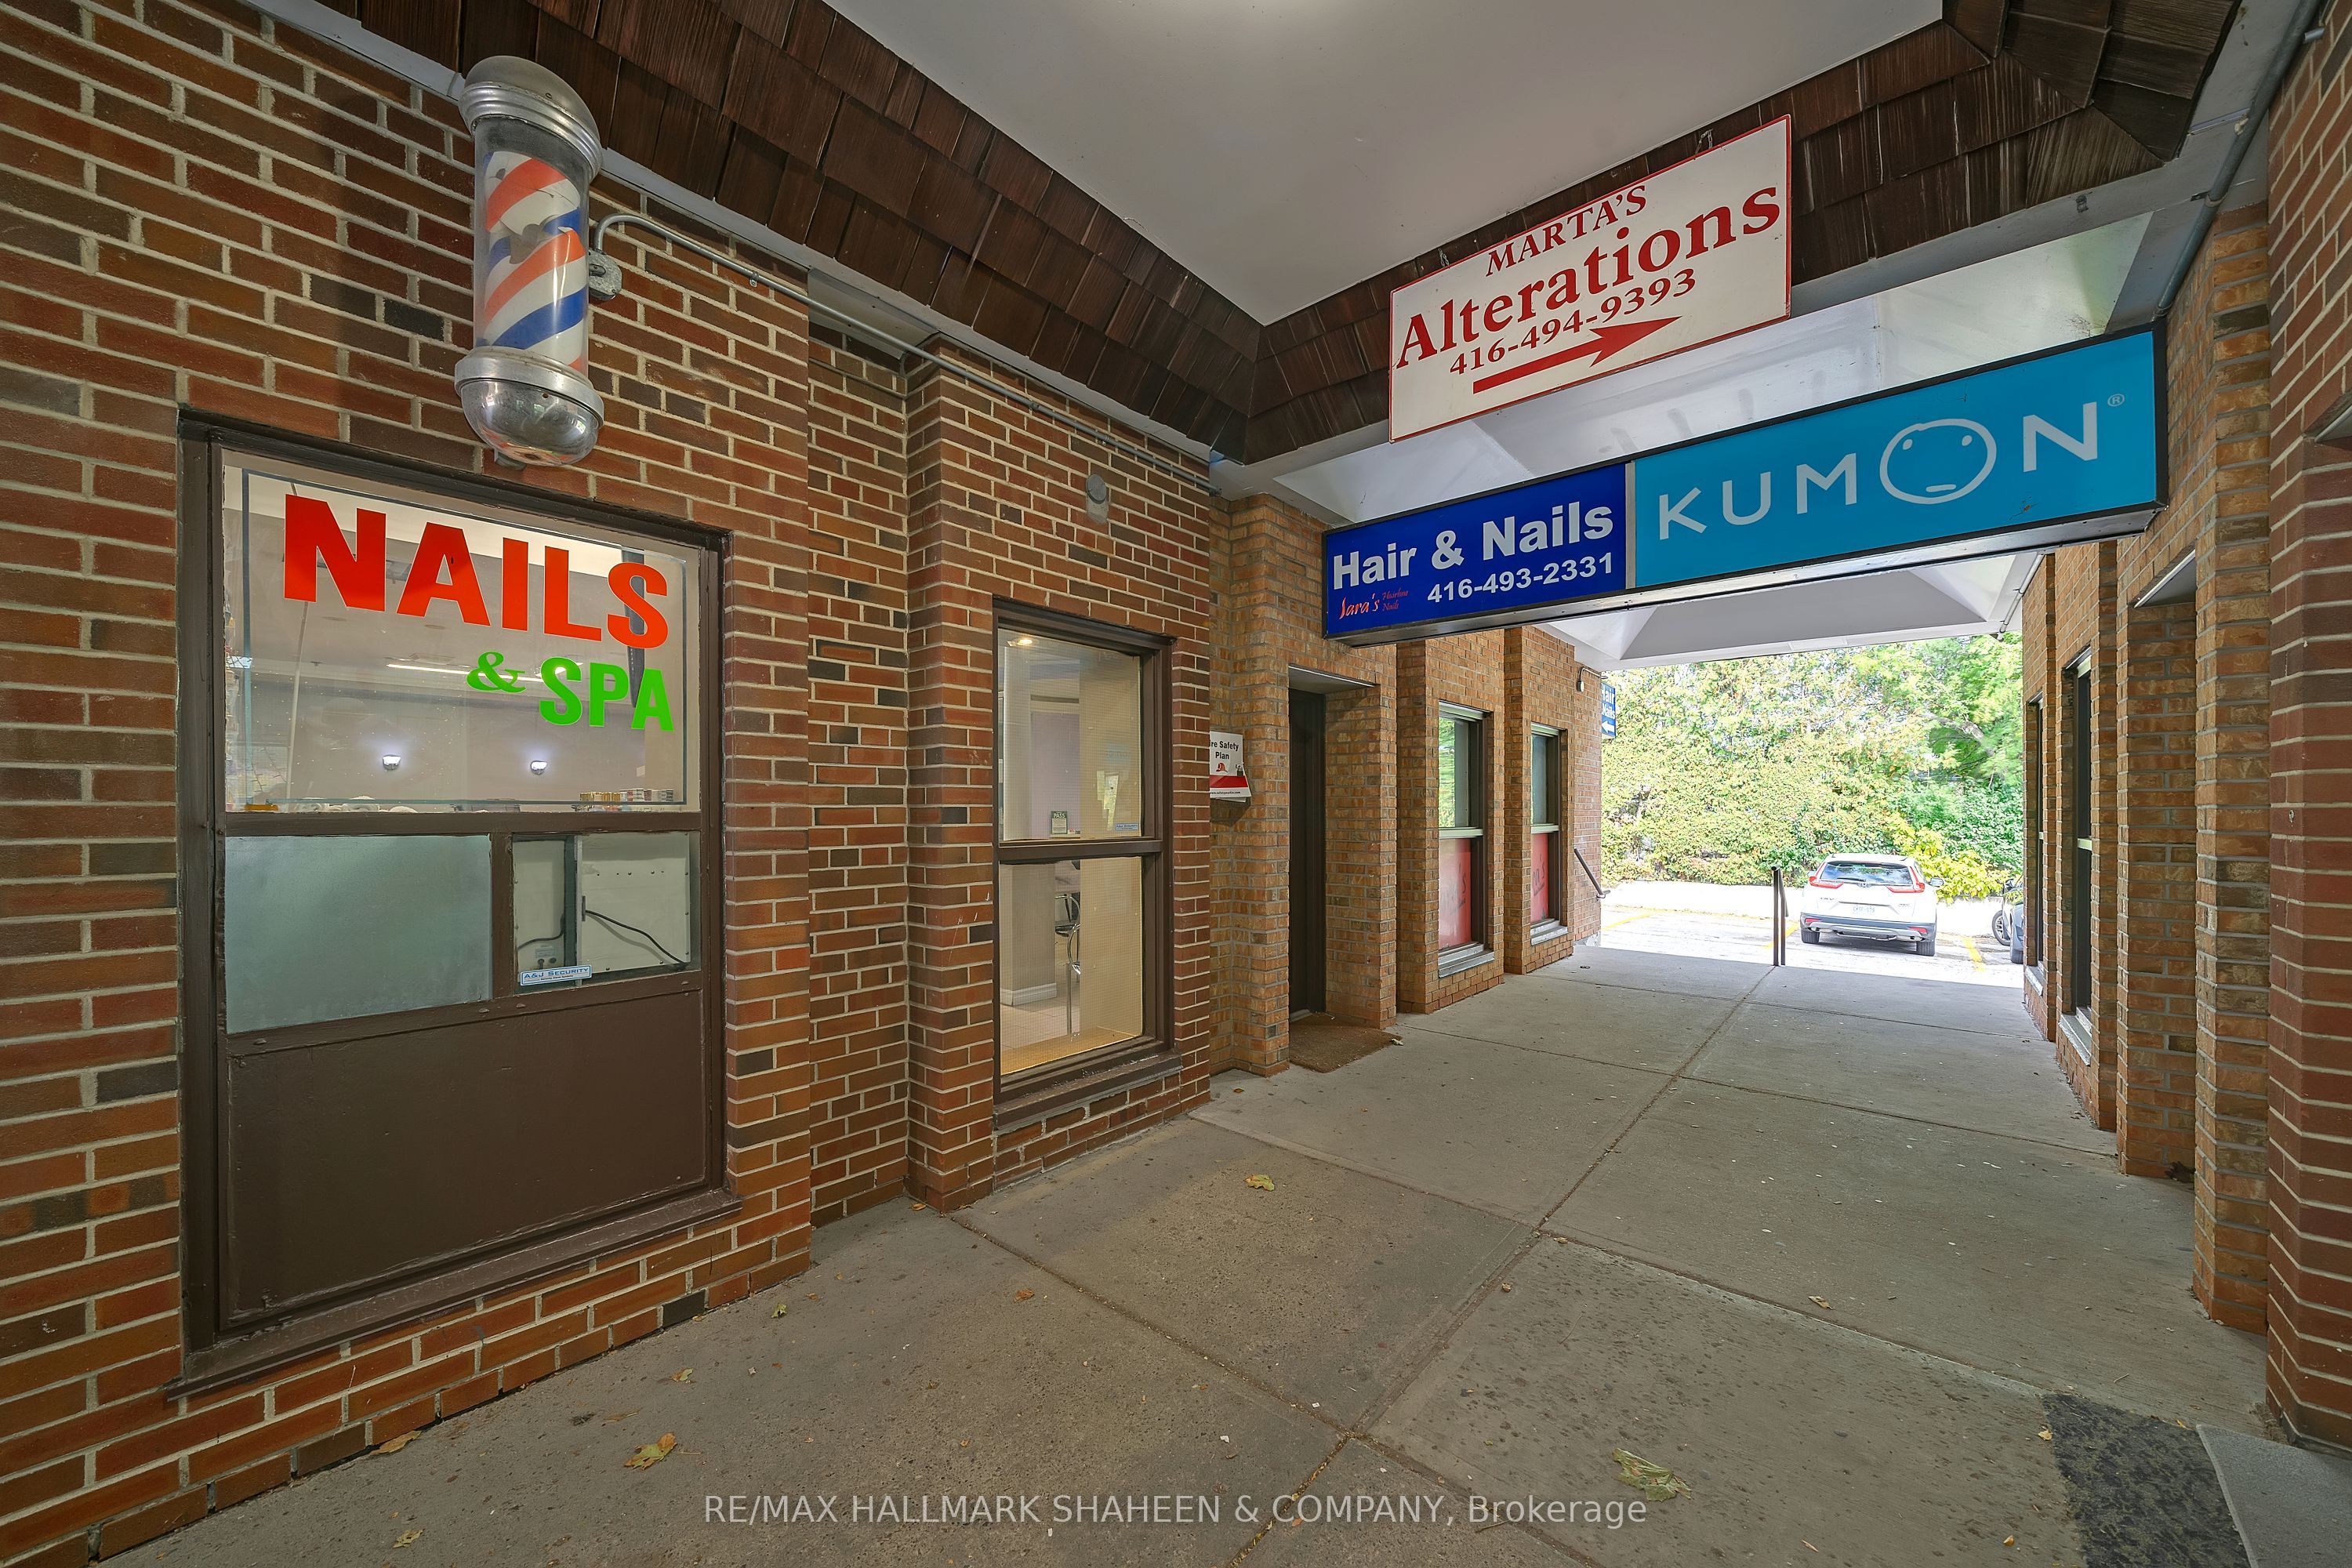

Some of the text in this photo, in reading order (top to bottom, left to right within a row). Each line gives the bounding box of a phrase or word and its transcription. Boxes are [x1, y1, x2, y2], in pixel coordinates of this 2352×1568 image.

[1485, 185, 1647, 277] MARTA'S
[1396, 186, 1781, 369] Alterations
[1449, 267, 1697, 375] 416-494-9393
[1659, 401, 2098, 540] KUMON
[284, 494, 670, 650] NAILS
[1333, 500, 1613, 590] Hair & Nails
[1427, 552, 1613, 604] 416-493-2331
[466, 652, 675, 731] & SPA
[1215, 751, 1230, 760] Plan
[1219, 740, 1240, 752] Safety
